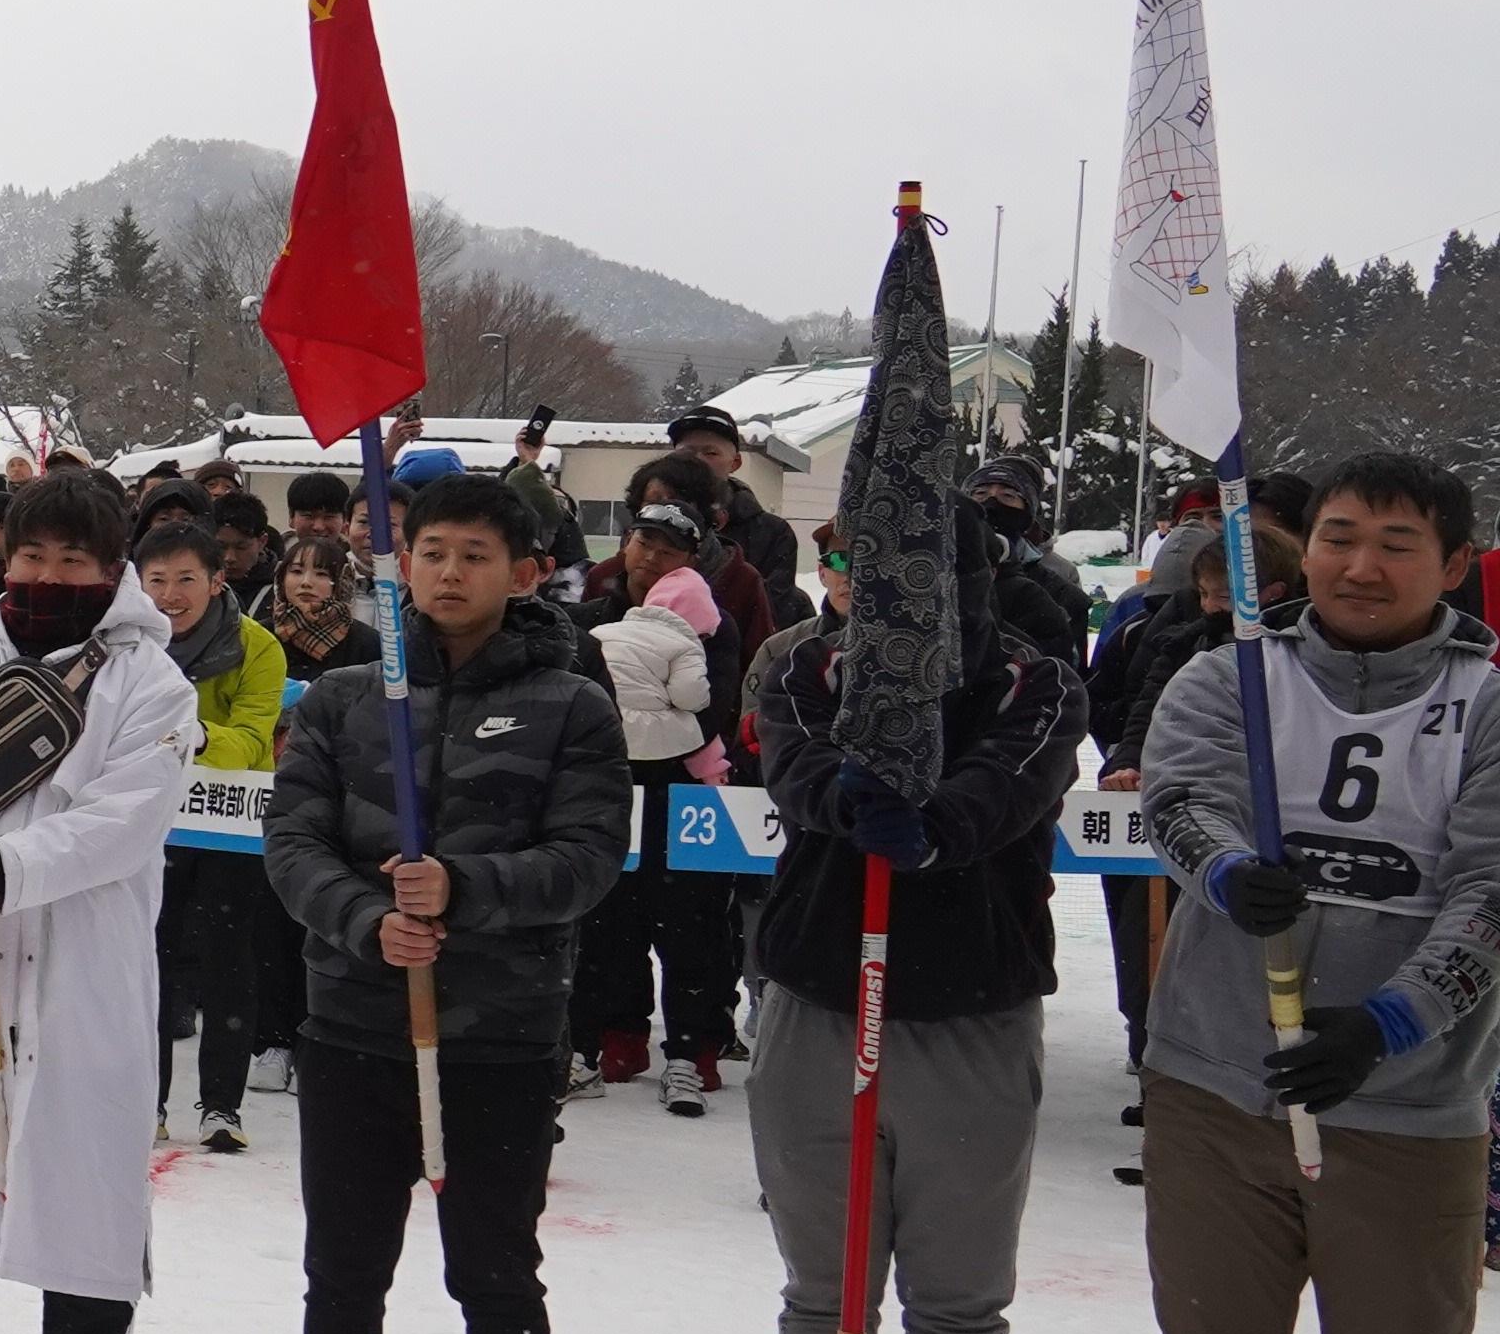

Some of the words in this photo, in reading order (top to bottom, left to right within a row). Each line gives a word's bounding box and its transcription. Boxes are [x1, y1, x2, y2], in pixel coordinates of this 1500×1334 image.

[380, 583, 405, 679] Conquest
[482, 716, 517, 730] NIKE
[1420, 698, 1468, 736] 21
[1318, 732, 1384, 823] 6
[179, 780, 274, 821] 合戦部(仮
[679, 805, 717, 845] 23
[855, 966, 885, 1072] Conquest
